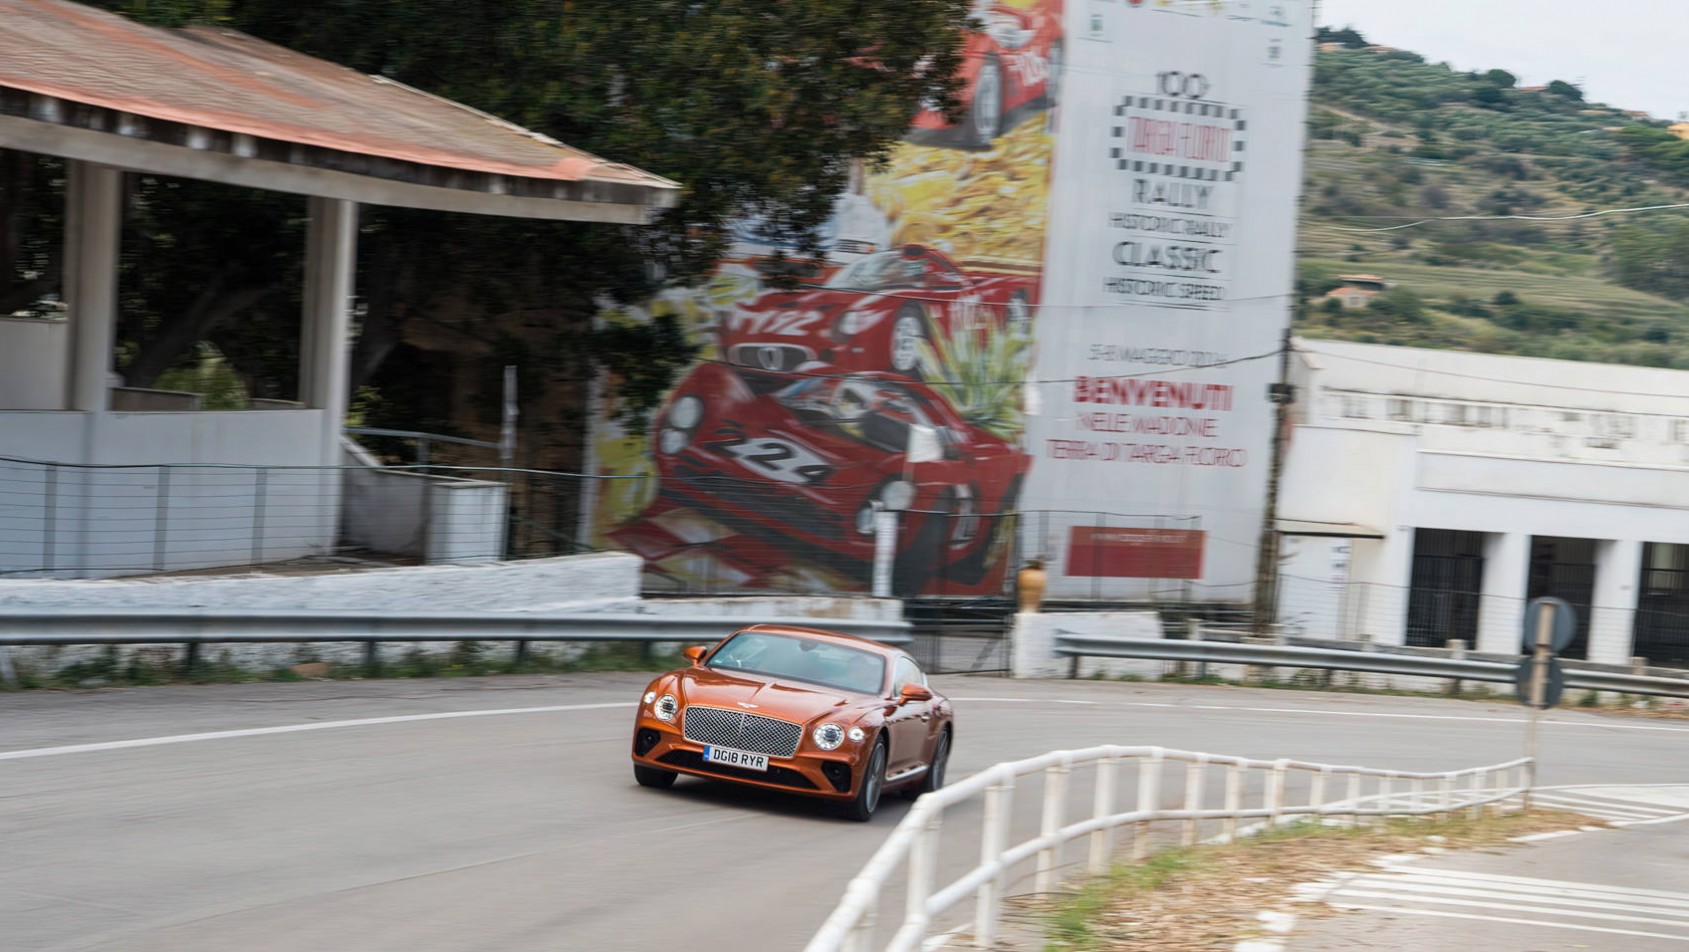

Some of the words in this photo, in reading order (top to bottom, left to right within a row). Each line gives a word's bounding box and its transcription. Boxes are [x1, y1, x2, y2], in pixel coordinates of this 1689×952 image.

[1132, 179, 1213, 209] RALLY
[1108, 212, 1183, 233] HISTORIC
[1184, 219, 1231, 238] RALLY
[1112, 241, 1222, 273] CLASSIC
[1103, 278, 1179, 298] HISTORIC
[1180, 283, 1226, 301] SPEED
[1074, 376, 1234, 411] BENVENUTI
[1078, 411, 1130, 433] NELLE
[1131, 415, 1218, 438] MADONIE
[1046, 439, 1098, 460] TERRA
[1102, 442, 1120, 461] DI
[1122, 443, 1180, 464] TARGA
[1184, 446, 1247, 467] FLORIO
[713, 749, 738, 763] DG18
[740, 753, 764, 768] RYR
